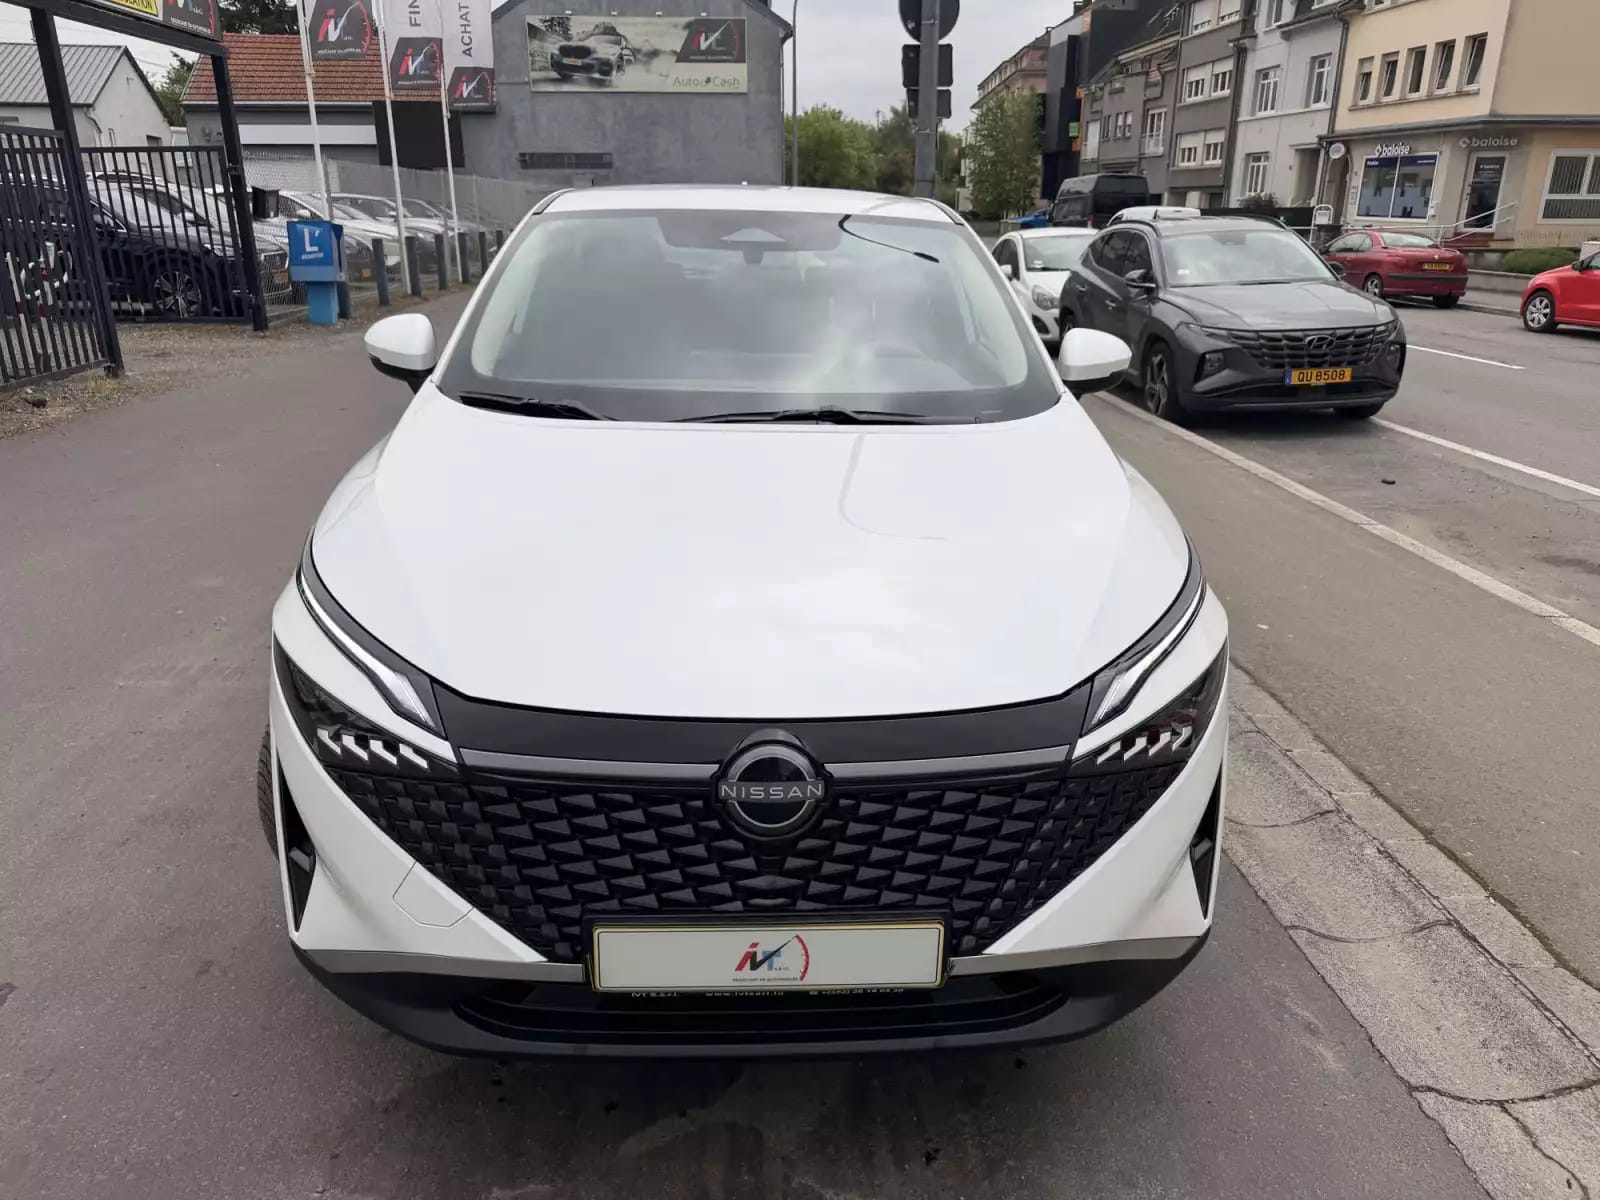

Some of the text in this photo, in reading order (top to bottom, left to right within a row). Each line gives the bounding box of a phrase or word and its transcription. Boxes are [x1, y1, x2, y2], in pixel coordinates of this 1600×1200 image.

[458, 3, 473, 58] ACHAT
[713, 76, 740, 88] Cash
[1472, 136, 1518, 148] baloise
[1382, 142, 1410, 157] baloise
[1297, 369, 1346, 383] QU 8508
[721, 783, 822, 799] NISSAN
